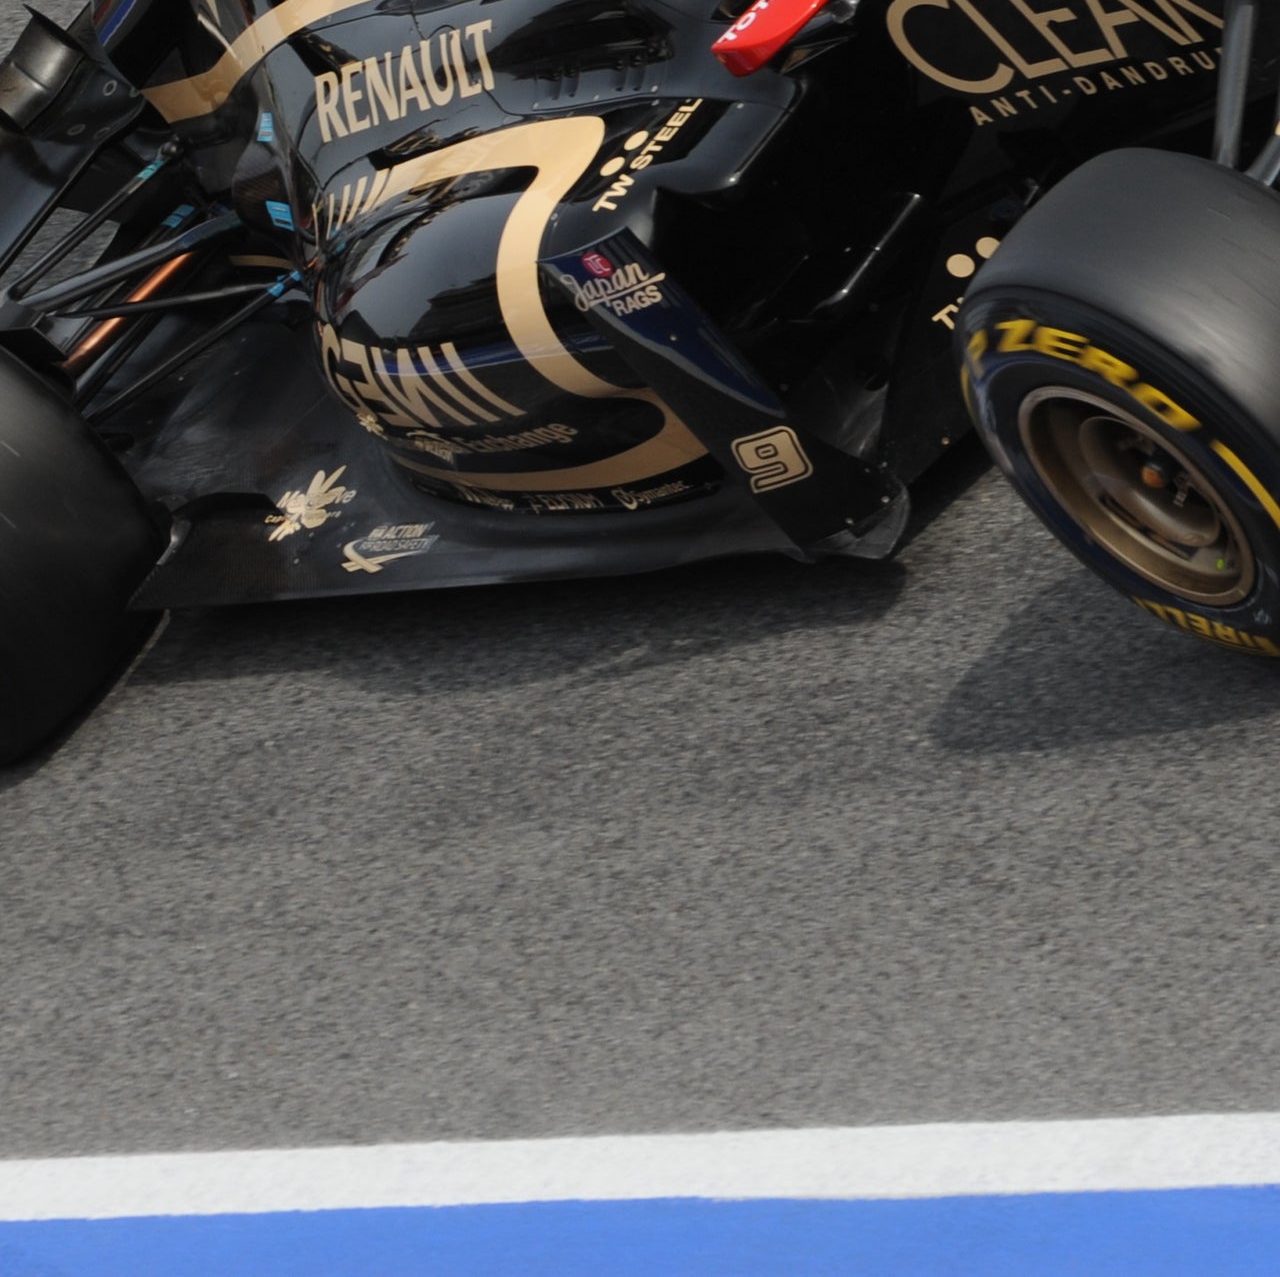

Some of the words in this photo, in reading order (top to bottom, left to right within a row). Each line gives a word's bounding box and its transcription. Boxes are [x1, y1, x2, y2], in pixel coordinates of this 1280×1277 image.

[314, 20, 497, 143] RENAULT
[969, 46, 1224, 126] ANTI-DANDRU
[592, 173, 635, 212] TW
[629, 98, 703, 170] STEEL
[560, 262, 650, 312] Japan
[612, 284, 662, 316] RAGS
[994, 319, 1203, 432] ZERO
[731, 425, 813, 494] 9
[383, 523, 429, 539] ACTION
